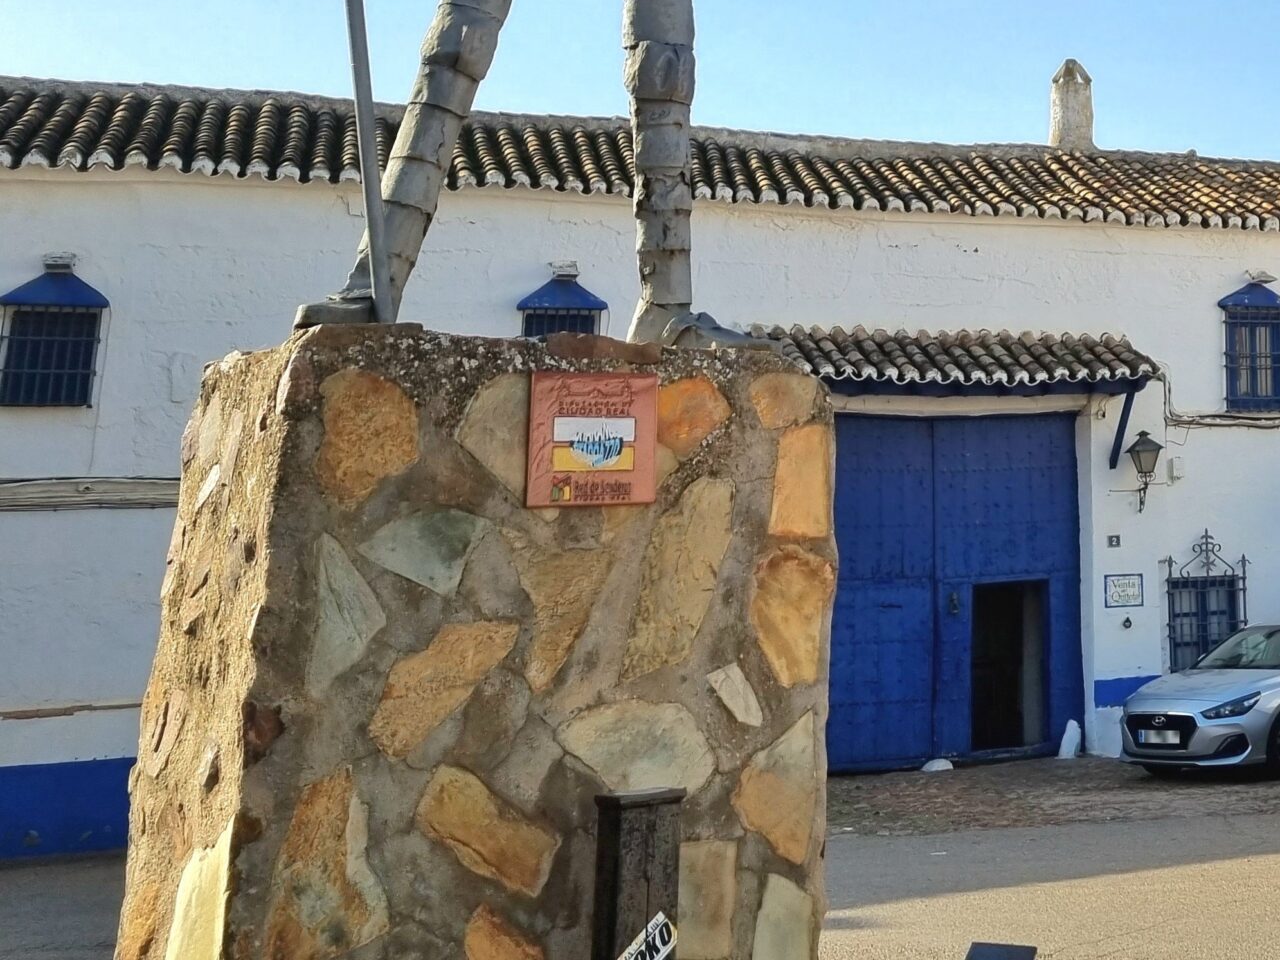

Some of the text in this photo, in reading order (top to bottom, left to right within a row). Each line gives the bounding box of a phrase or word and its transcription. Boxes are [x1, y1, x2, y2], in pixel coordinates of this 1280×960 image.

[558, 407, 630, 416] CIUDAD REAL
[1111, 537, 1118, 545] 2
